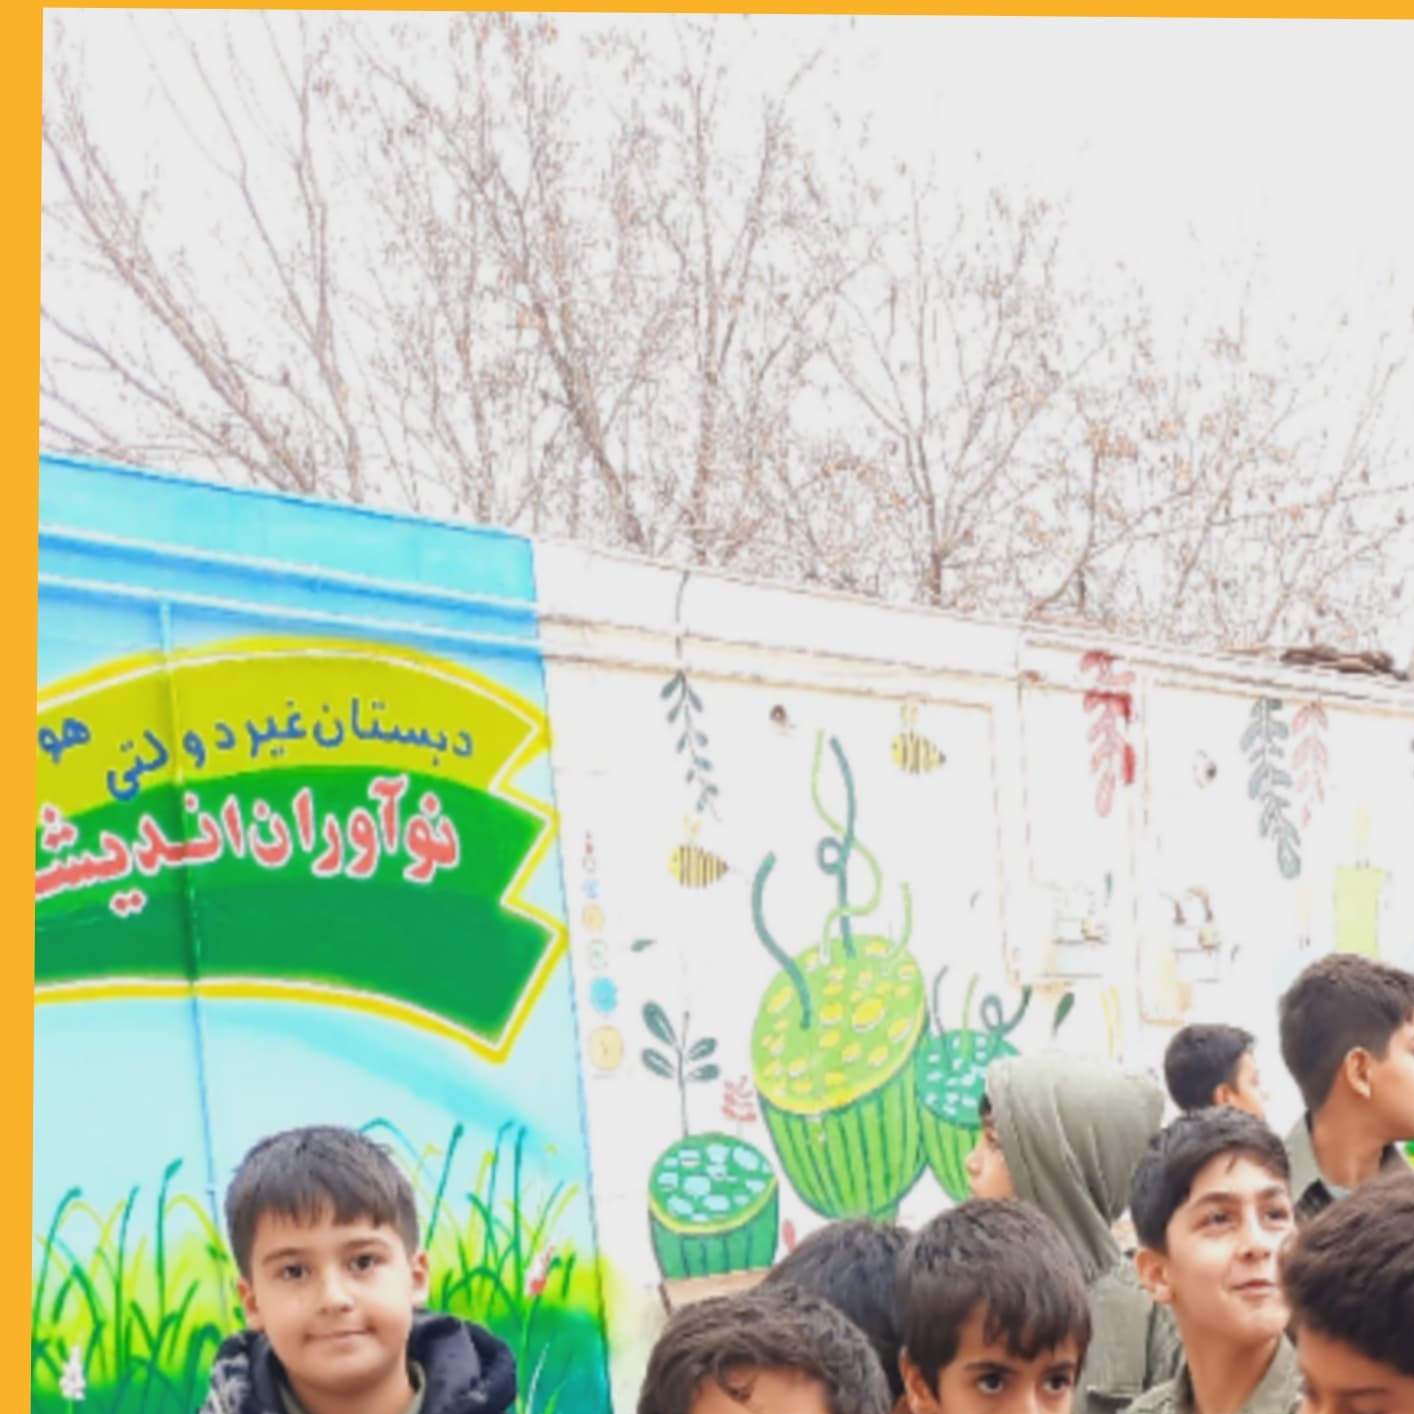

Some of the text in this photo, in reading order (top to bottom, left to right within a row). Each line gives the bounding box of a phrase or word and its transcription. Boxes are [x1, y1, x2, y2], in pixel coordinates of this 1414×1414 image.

[313, 697, 472, 767] دبستان
[35, 774, 461, 917] نوآوران اندیش
